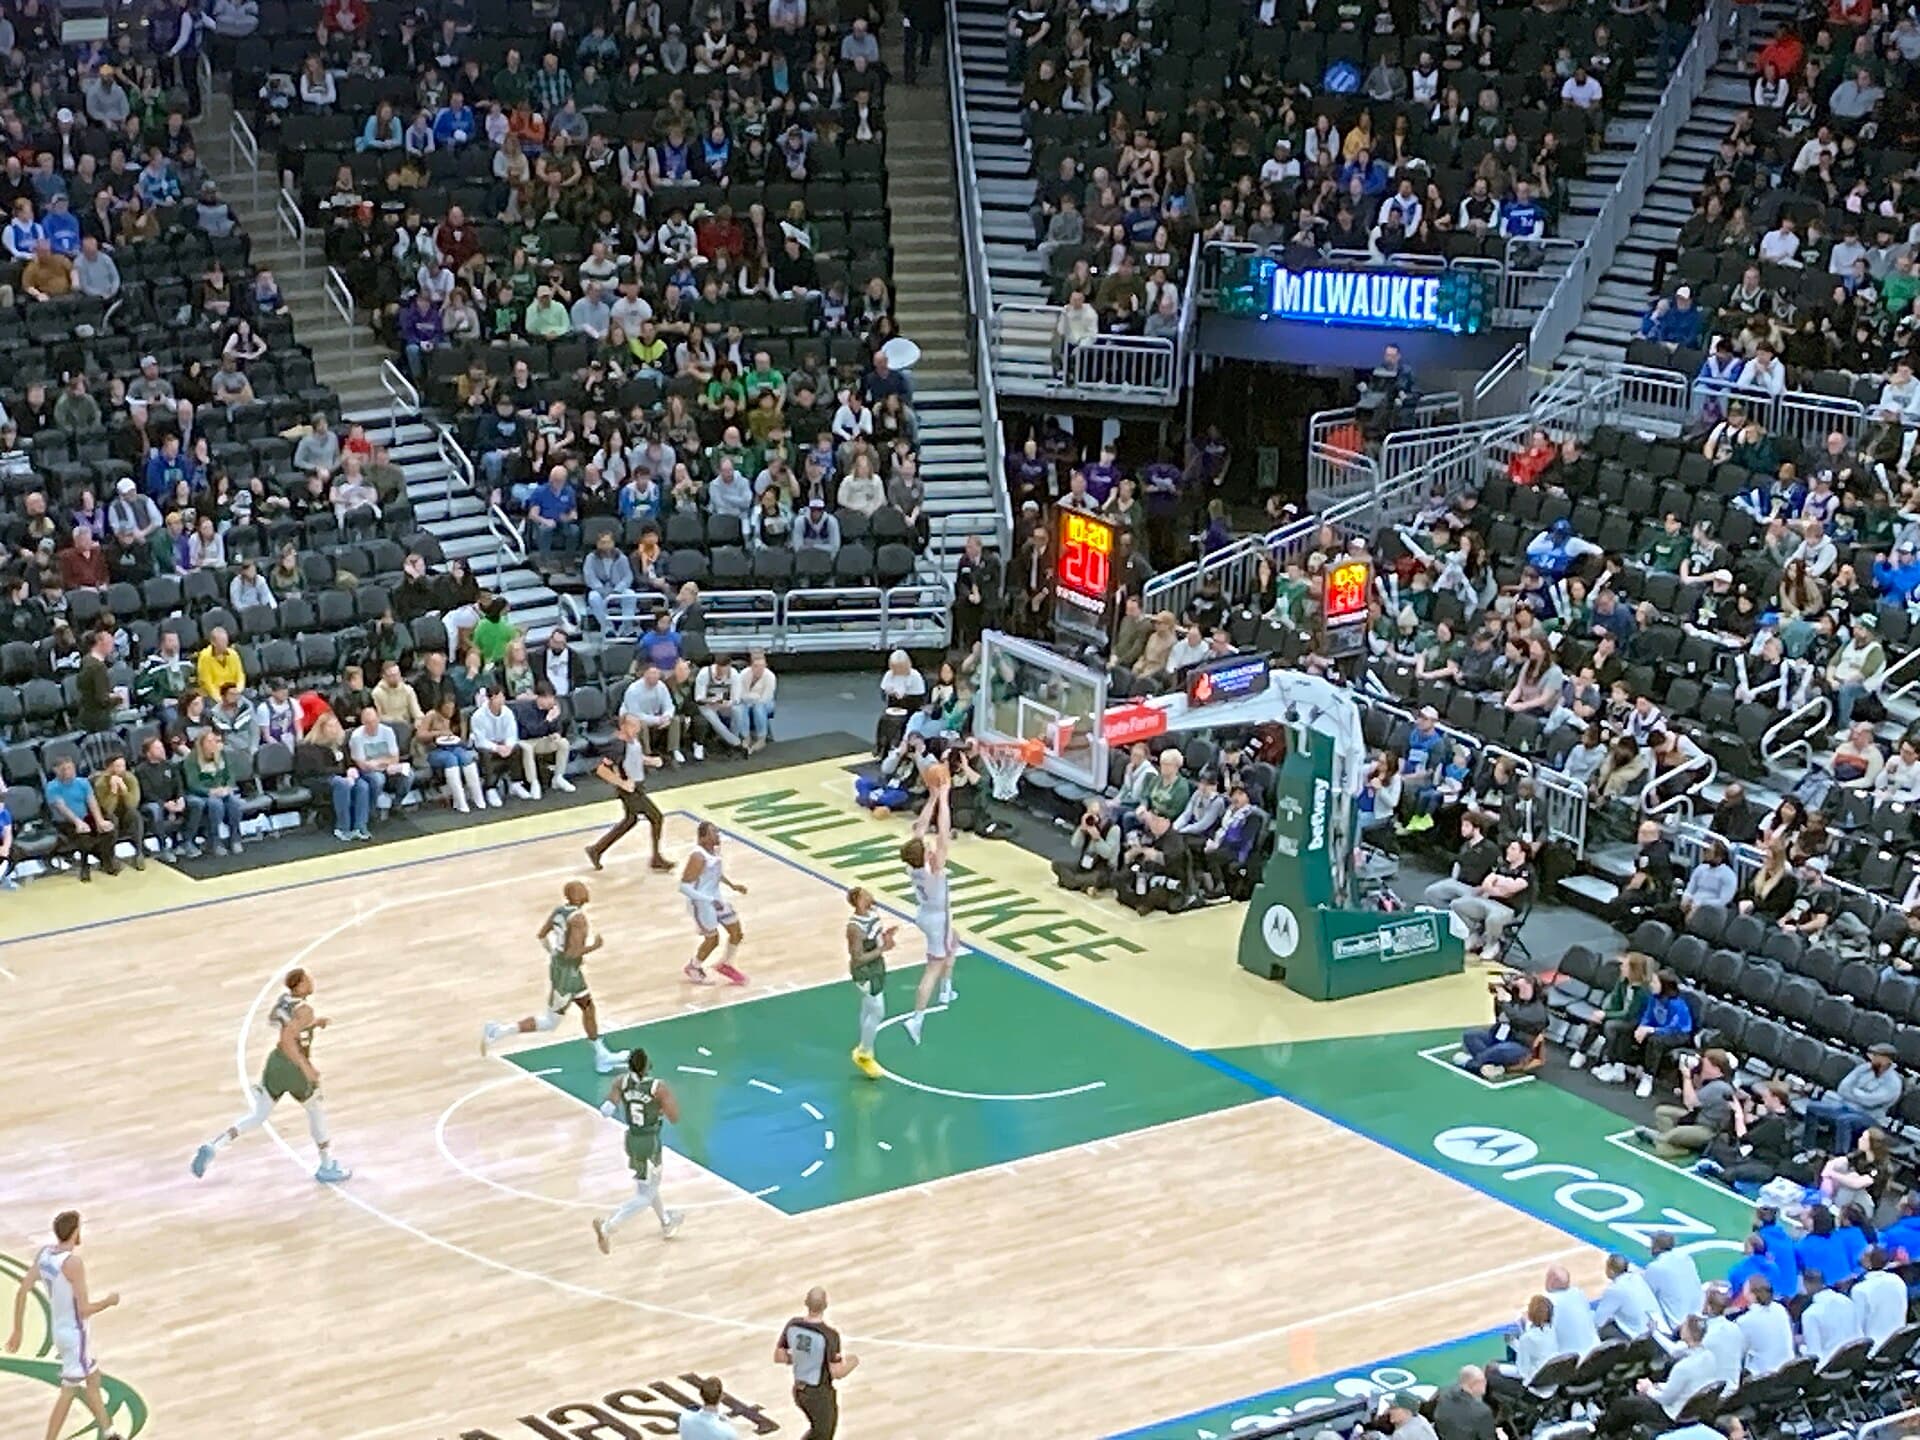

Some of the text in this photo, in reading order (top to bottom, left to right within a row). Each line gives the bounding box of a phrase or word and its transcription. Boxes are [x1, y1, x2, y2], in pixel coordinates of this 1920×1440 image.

[1272, 268, 1440, 320] MILWAUKEE
[1065, 541, 1106, 592] 20
[1308, 777, 1330, 850] betway
